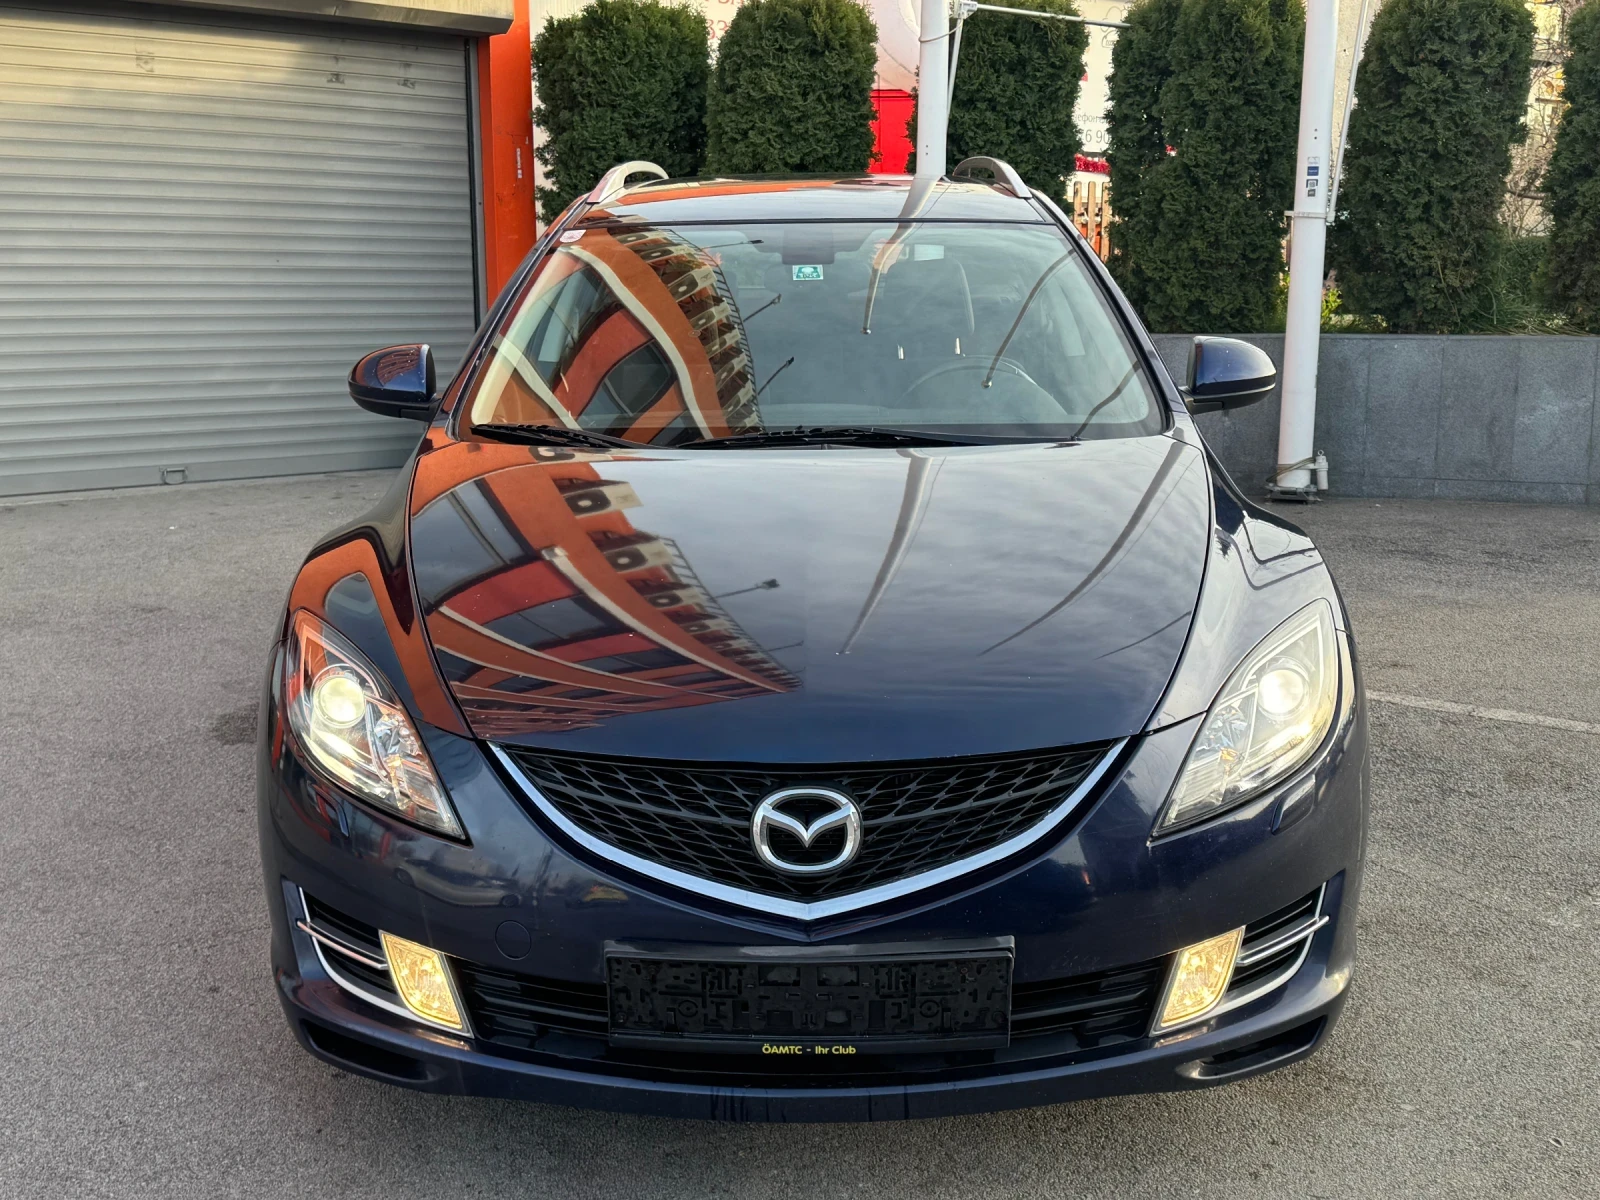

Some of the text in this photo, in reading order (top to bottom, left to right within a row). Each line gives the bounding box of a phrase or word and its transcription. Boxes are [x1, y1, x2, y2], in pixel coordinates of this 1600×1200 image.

[761, 1043, 803, 1055] ÖAMTC
[814, 1045, 830, 1055] Ihr
[831, 1045, 857, 1055] Club
